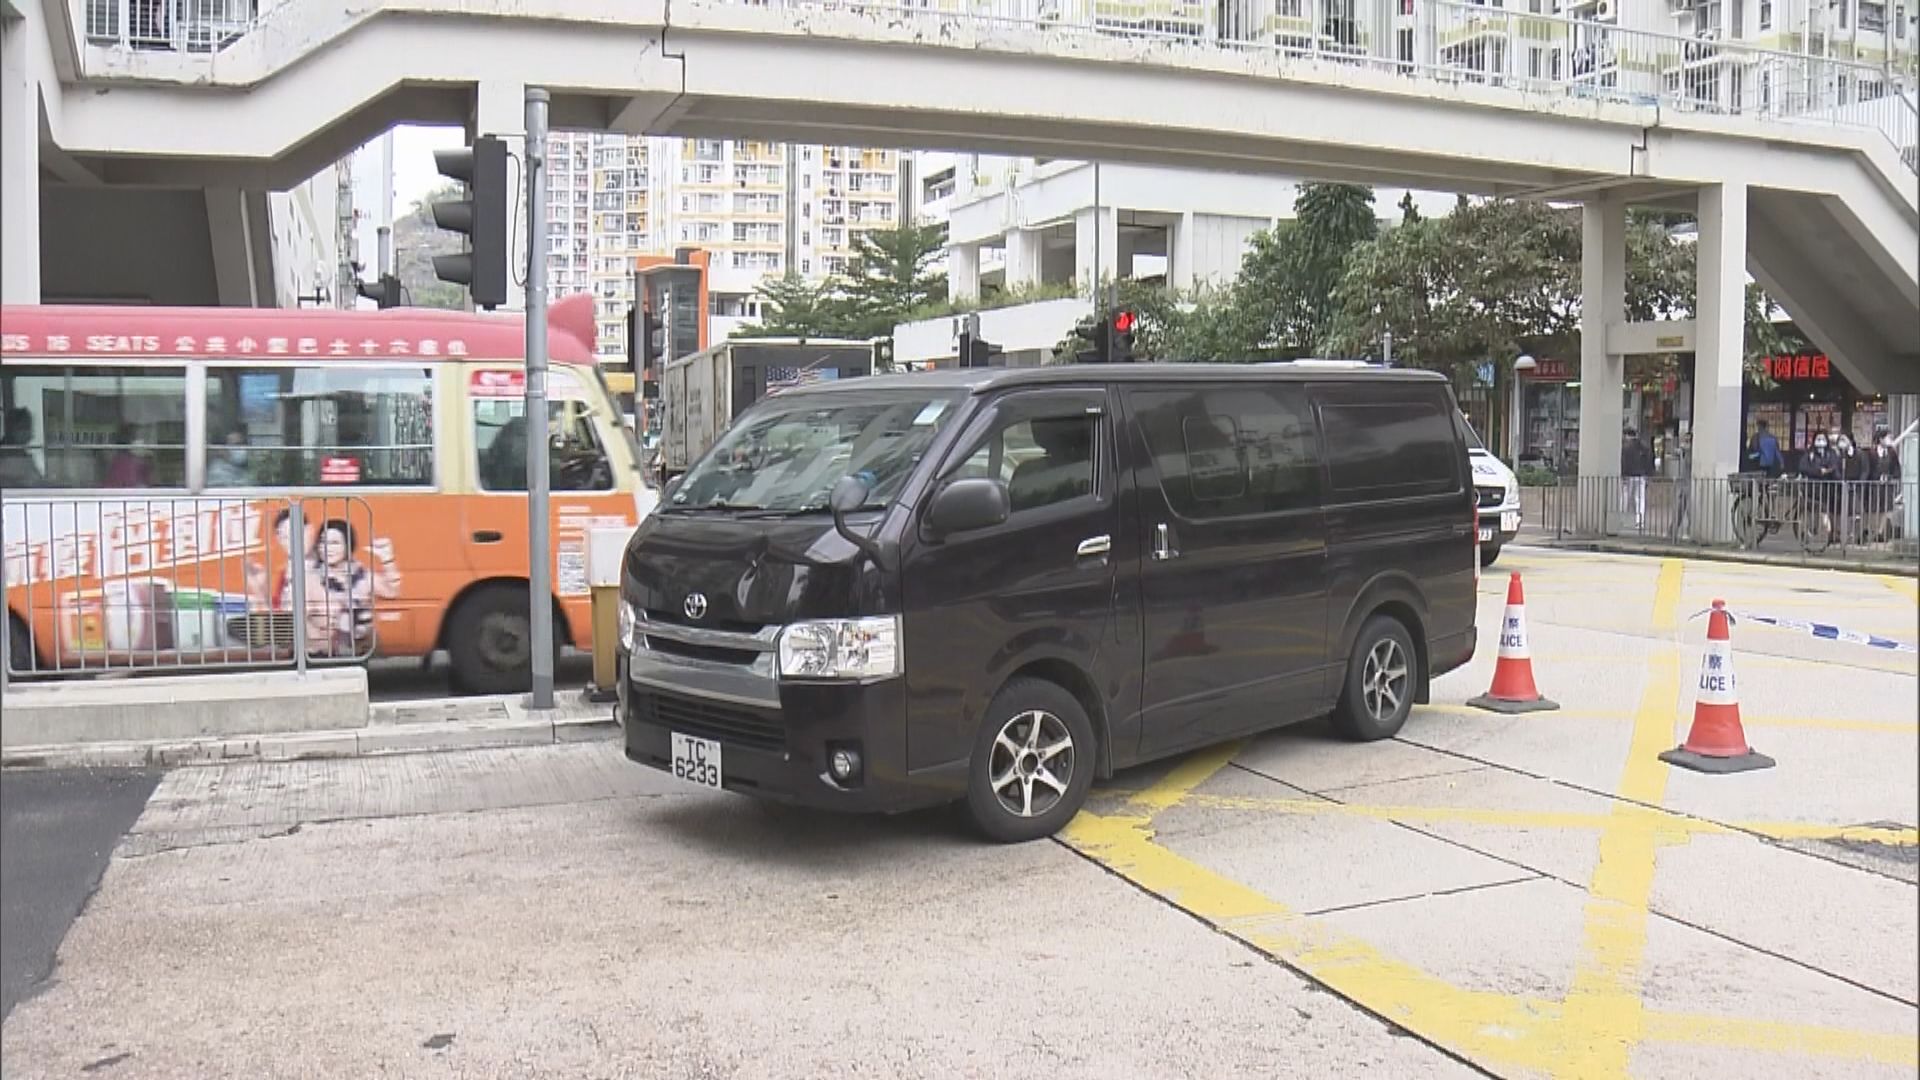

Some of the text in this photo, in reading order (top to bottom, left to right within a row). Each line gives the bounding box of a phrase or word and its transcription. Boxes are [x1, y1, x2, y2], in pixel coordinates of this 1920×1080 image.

[86, 336, 160, 351] SEATS
[685, 738, 706, 761] TC
[676, 756, 718, 787] 6233
